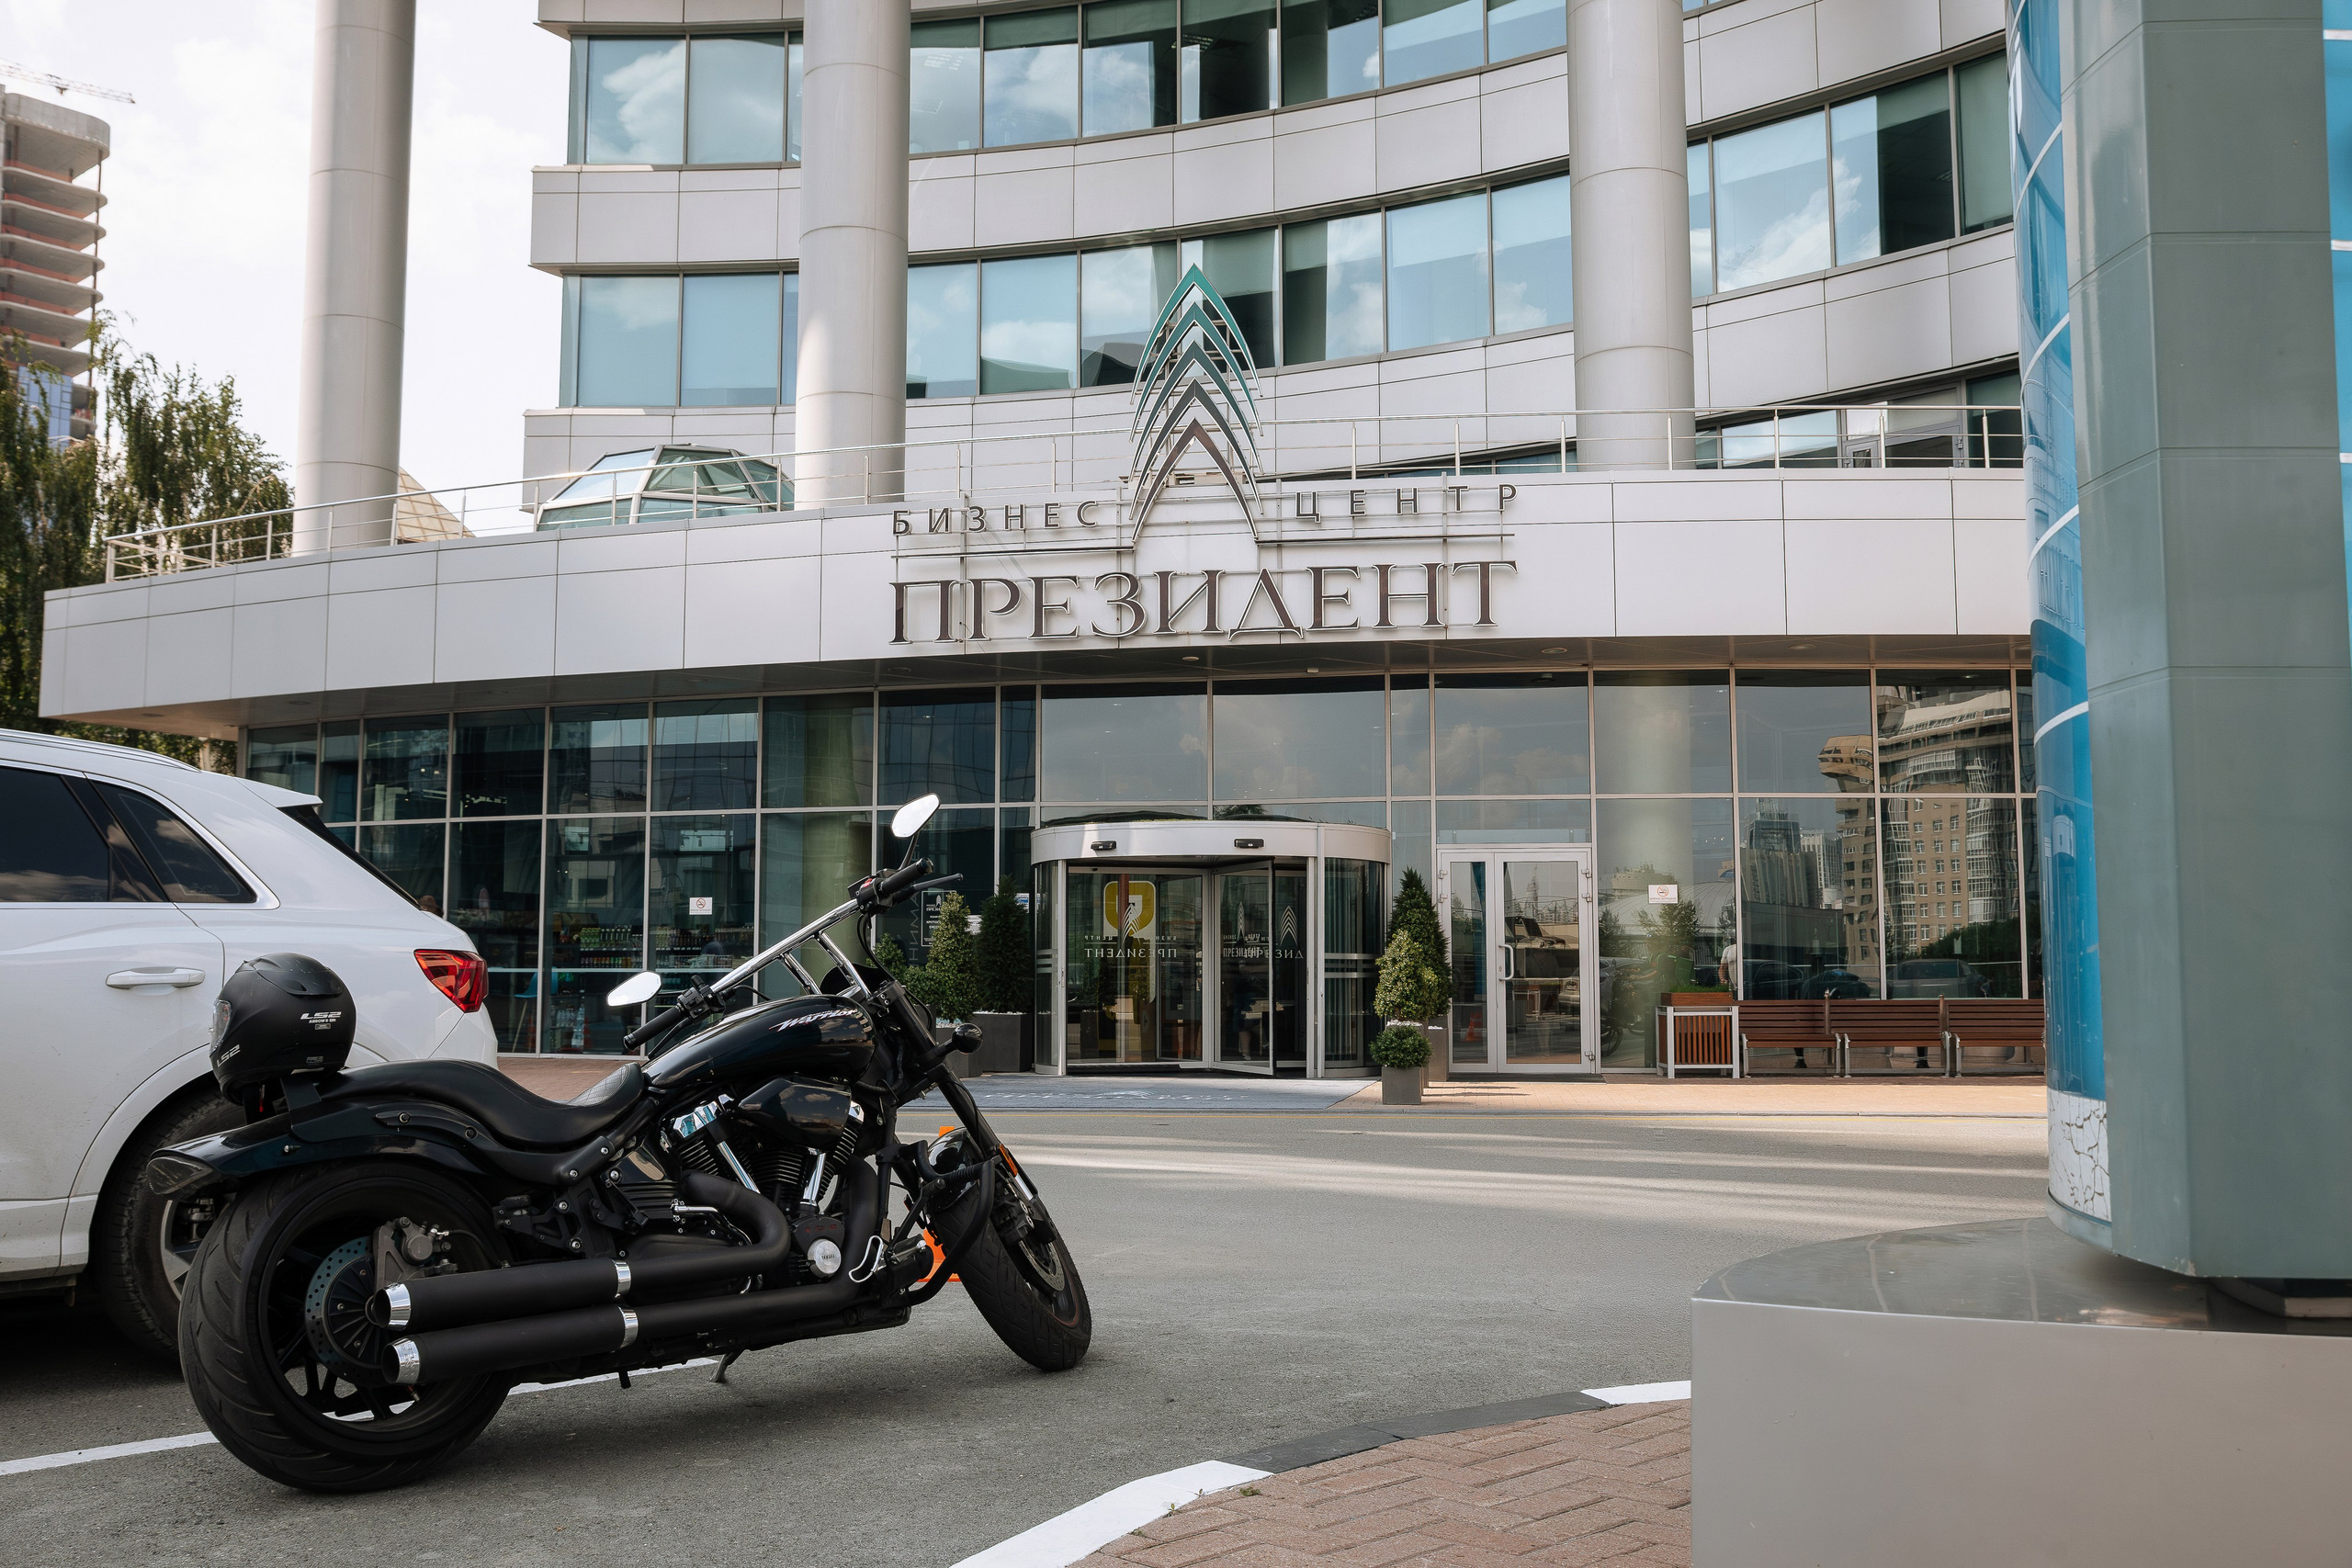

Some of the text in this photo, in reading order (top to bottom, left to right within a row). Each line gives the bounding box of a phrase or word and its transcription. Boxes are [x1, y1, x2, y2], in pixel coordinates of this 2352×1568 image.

[891, 482, 1519, 536] БИЗНЕС ЦЕНТР
[888, 558, 1521, 646] ПРЕЗИДЕНТ
[300, 1011, 342, 1020] LS2
[217, 1043, 241, 1067] LS2
